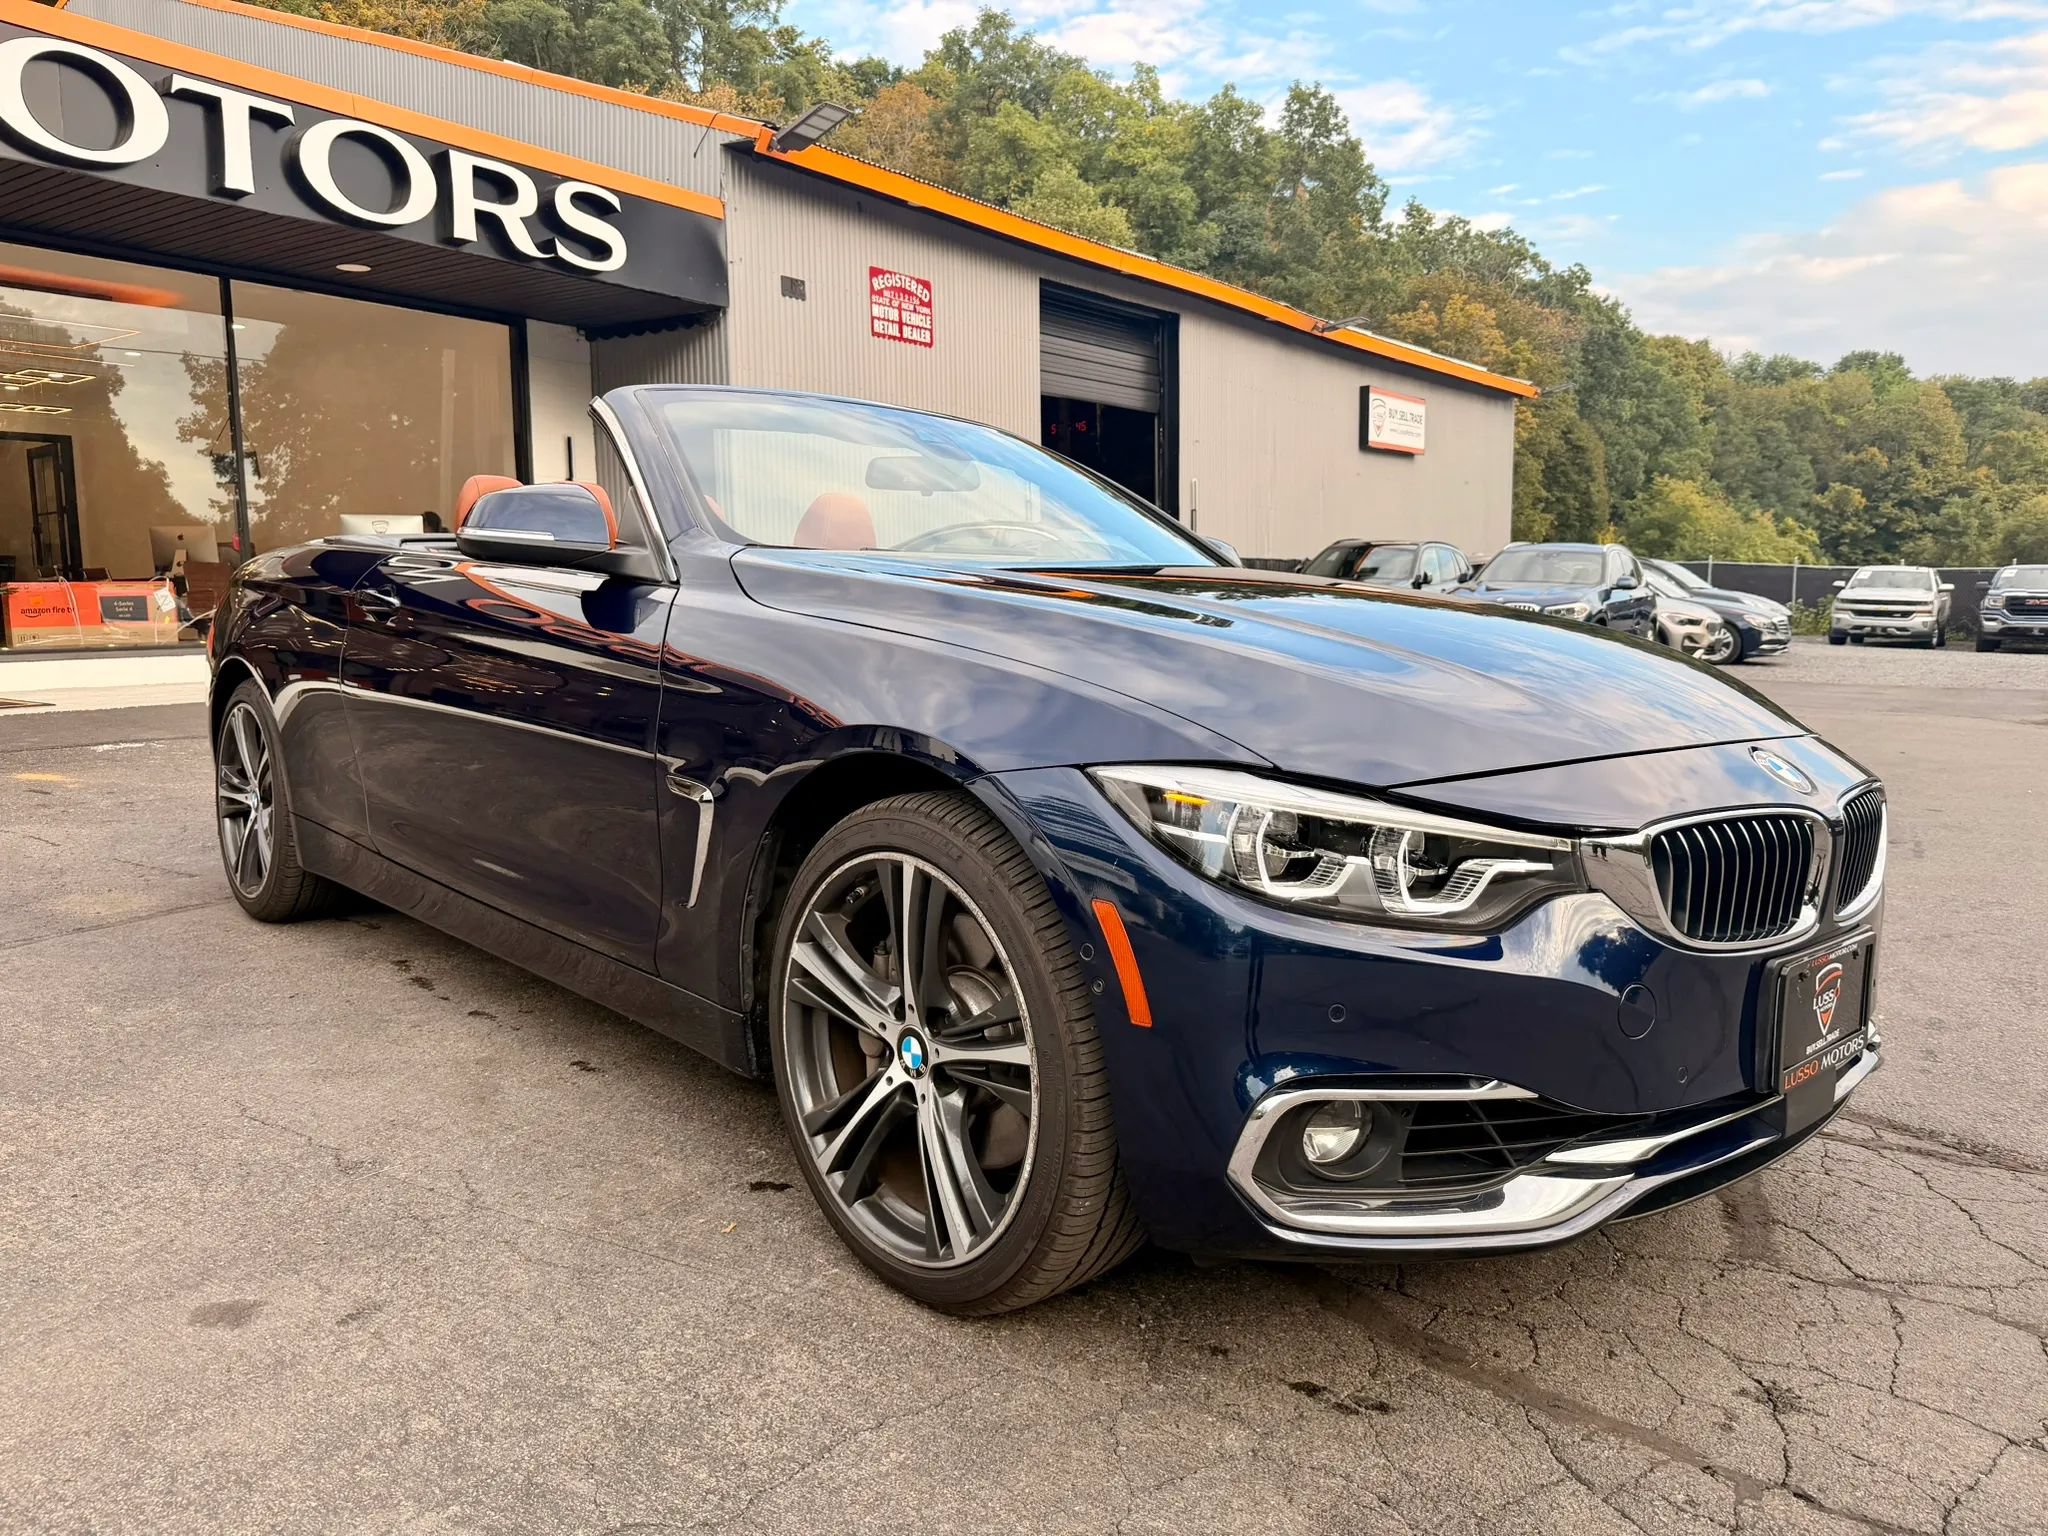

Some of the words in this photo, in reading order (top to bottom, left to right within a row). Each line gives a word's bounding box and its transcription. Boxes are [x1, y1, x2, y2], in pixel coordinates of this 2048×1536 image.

[0, 36, 628, 273] OTORS
[872, 273, 930, 303] REGISTERED
[872, 303, 900, 322] MOTOR
[901, 310, 932, 329] VEHICLE
[873, 318, 901, 337] RETAIL
[902, 325, 931, 344] DEALER
[20, 607, 51, 618] amazon
[52, 605, 66, 614] fire
[1812, 986, 1841, 1010] LUSSO
[1784, 1059, 1819, 1090] LUSSO
[1820, 1034, 1865, 1071] MOTORS
